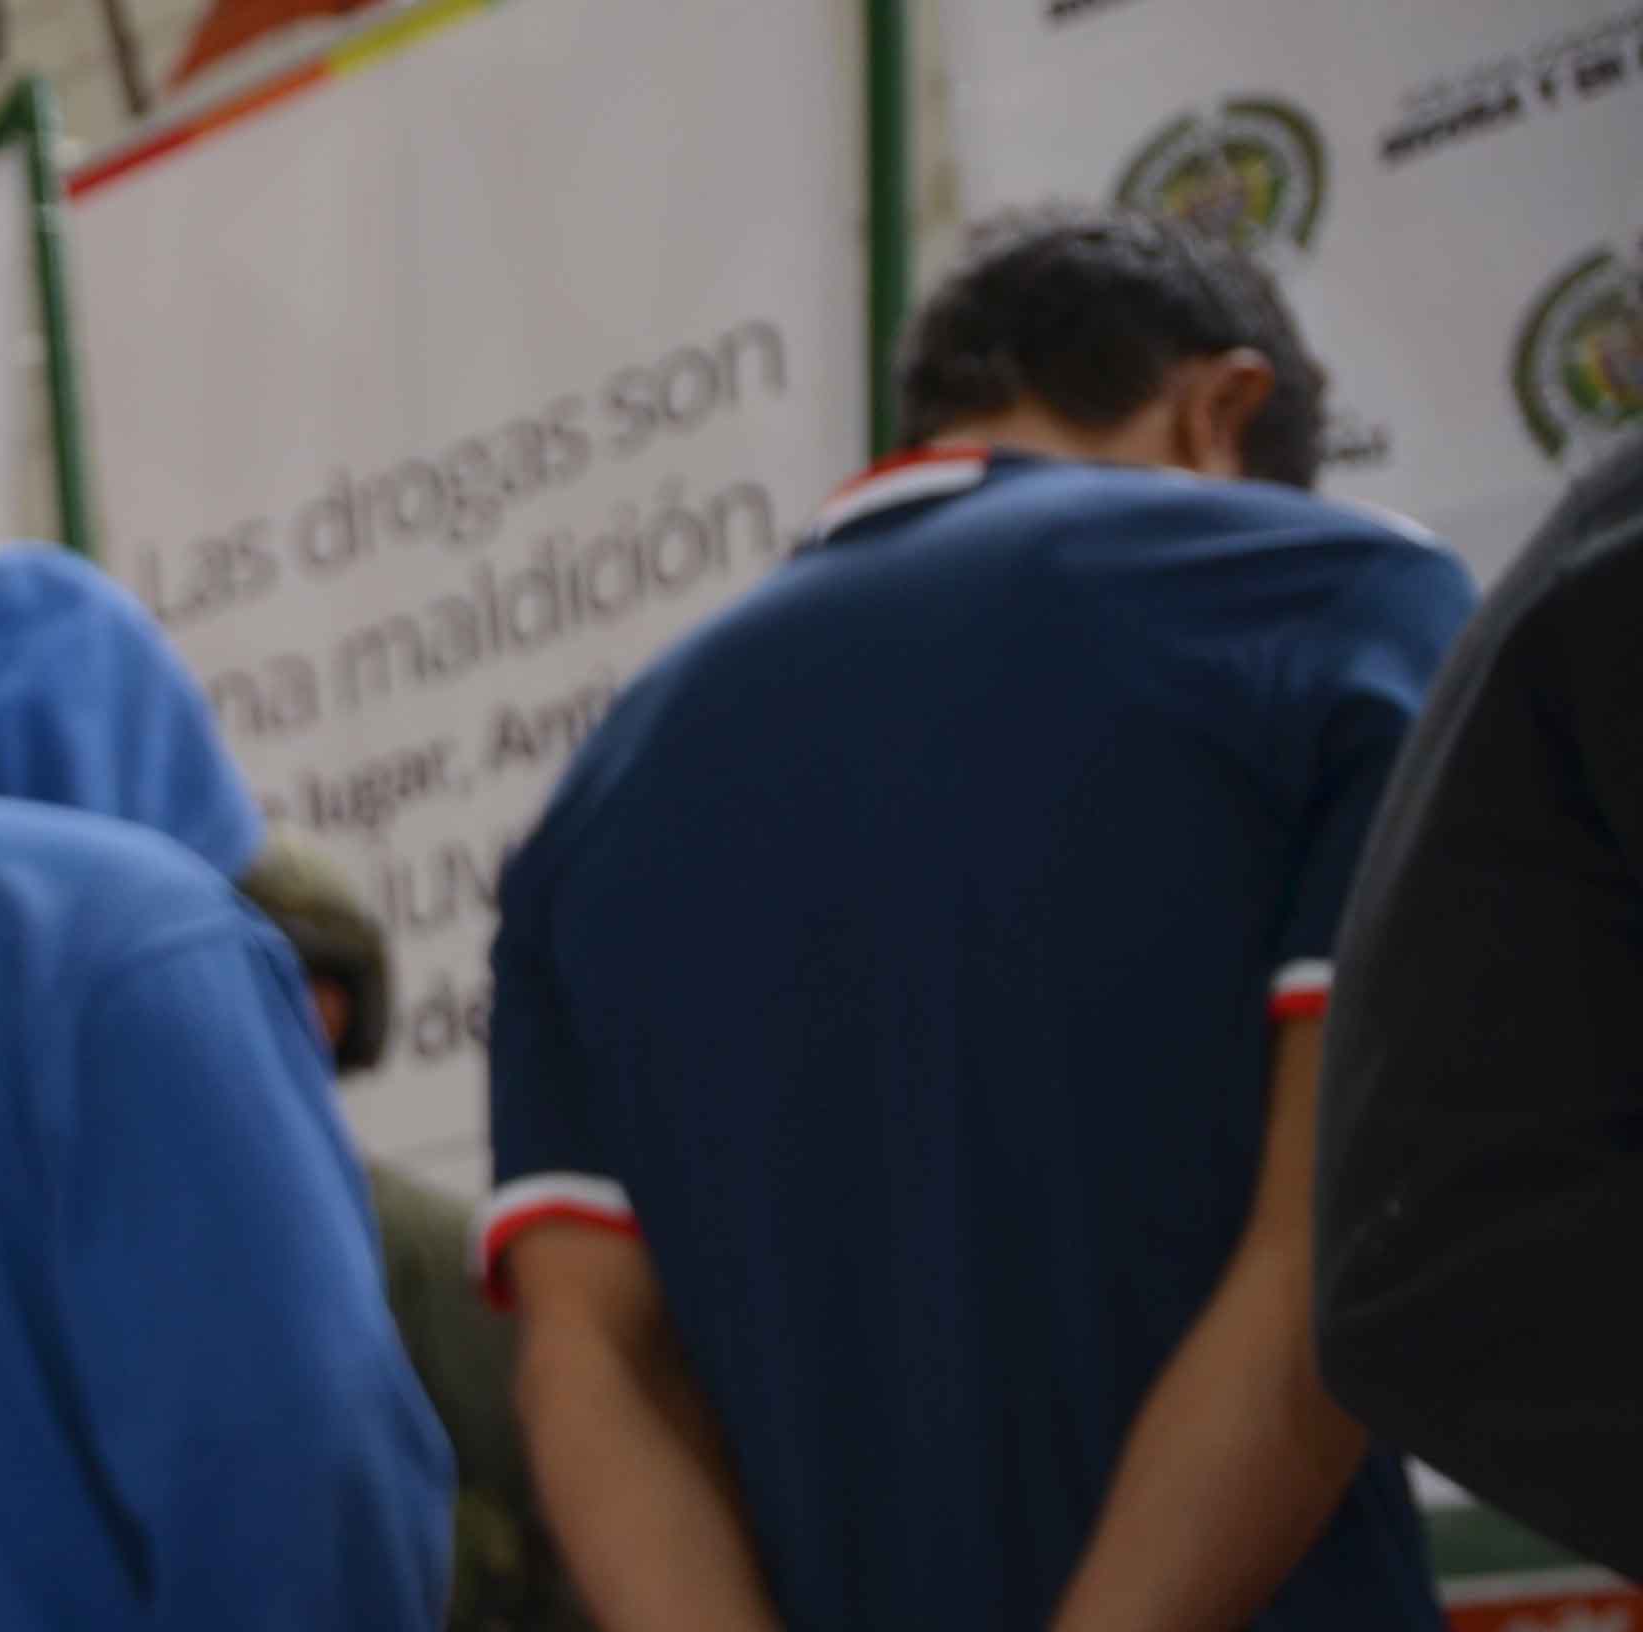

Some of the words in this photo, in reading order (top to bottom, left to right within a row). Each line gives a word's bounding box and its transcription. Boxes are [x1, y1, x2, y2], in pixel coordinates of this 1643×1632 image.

[145, 520, 280, 625] Las
[293, 398, 593, 580] drogas
[603, 317, 789, 458] son
[208, 648, 321, 742] na
[335, 473, 779, 715] maldición
